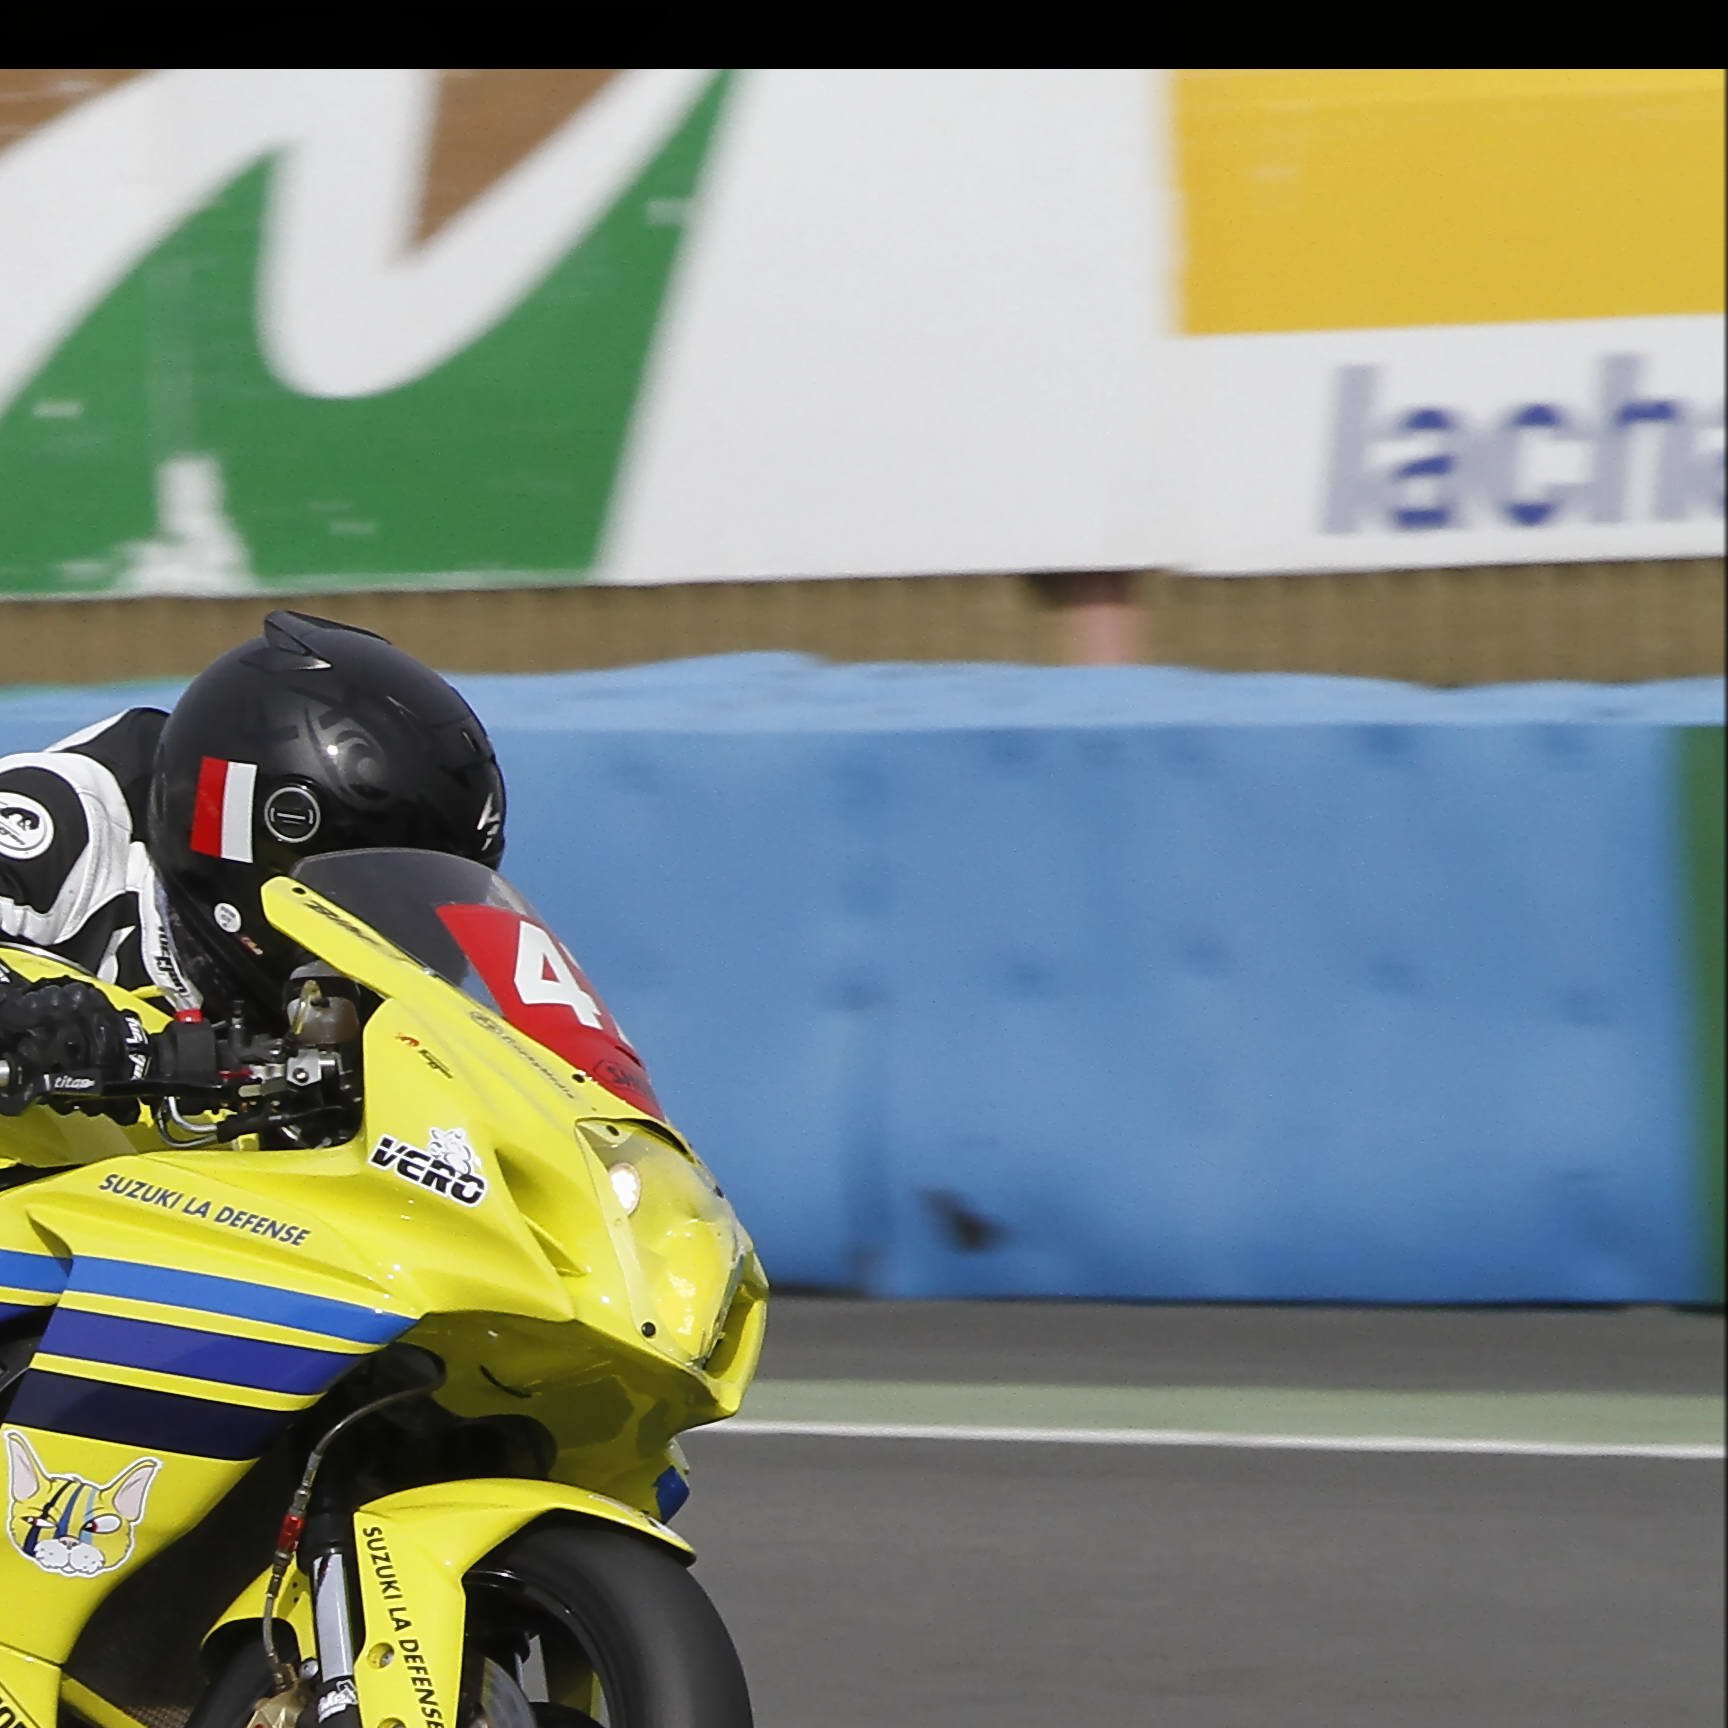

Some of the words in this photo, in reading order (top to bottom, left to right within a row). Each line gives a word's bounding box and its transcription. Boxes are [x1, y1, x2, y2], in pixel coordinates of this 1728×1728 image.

[370, 1137, 486, 1205] VERO
[99, 1172, 183, 1210] SUZUKI
[182, 1196, 212, 1219] LA
[214, 1205, 311, 1246] DEFENSE
[362, 1526, 403, 1600] SUZUKI
[388, 1605, 410, 1632] LA
